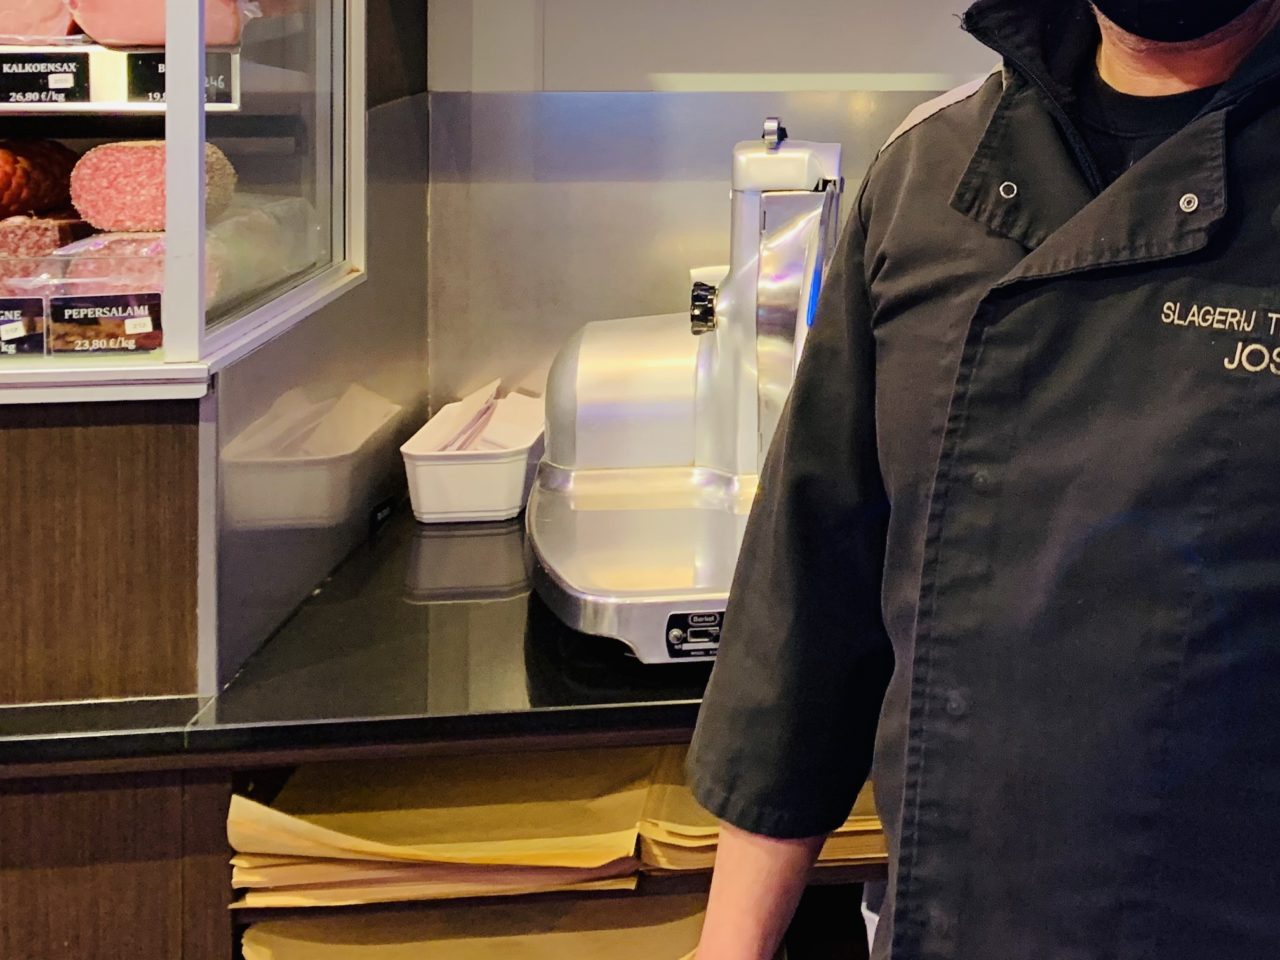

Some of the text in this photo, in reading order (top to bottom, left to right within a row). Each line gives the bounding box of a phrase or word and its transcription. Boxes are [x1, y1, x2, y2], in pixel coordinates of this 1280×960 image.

[2, 62, 77, 73] KALKOENSAX
[64, 305, 149, 320] PEPERSALAMI
[1161, 301, 1257, 332] SLAGERIJ
